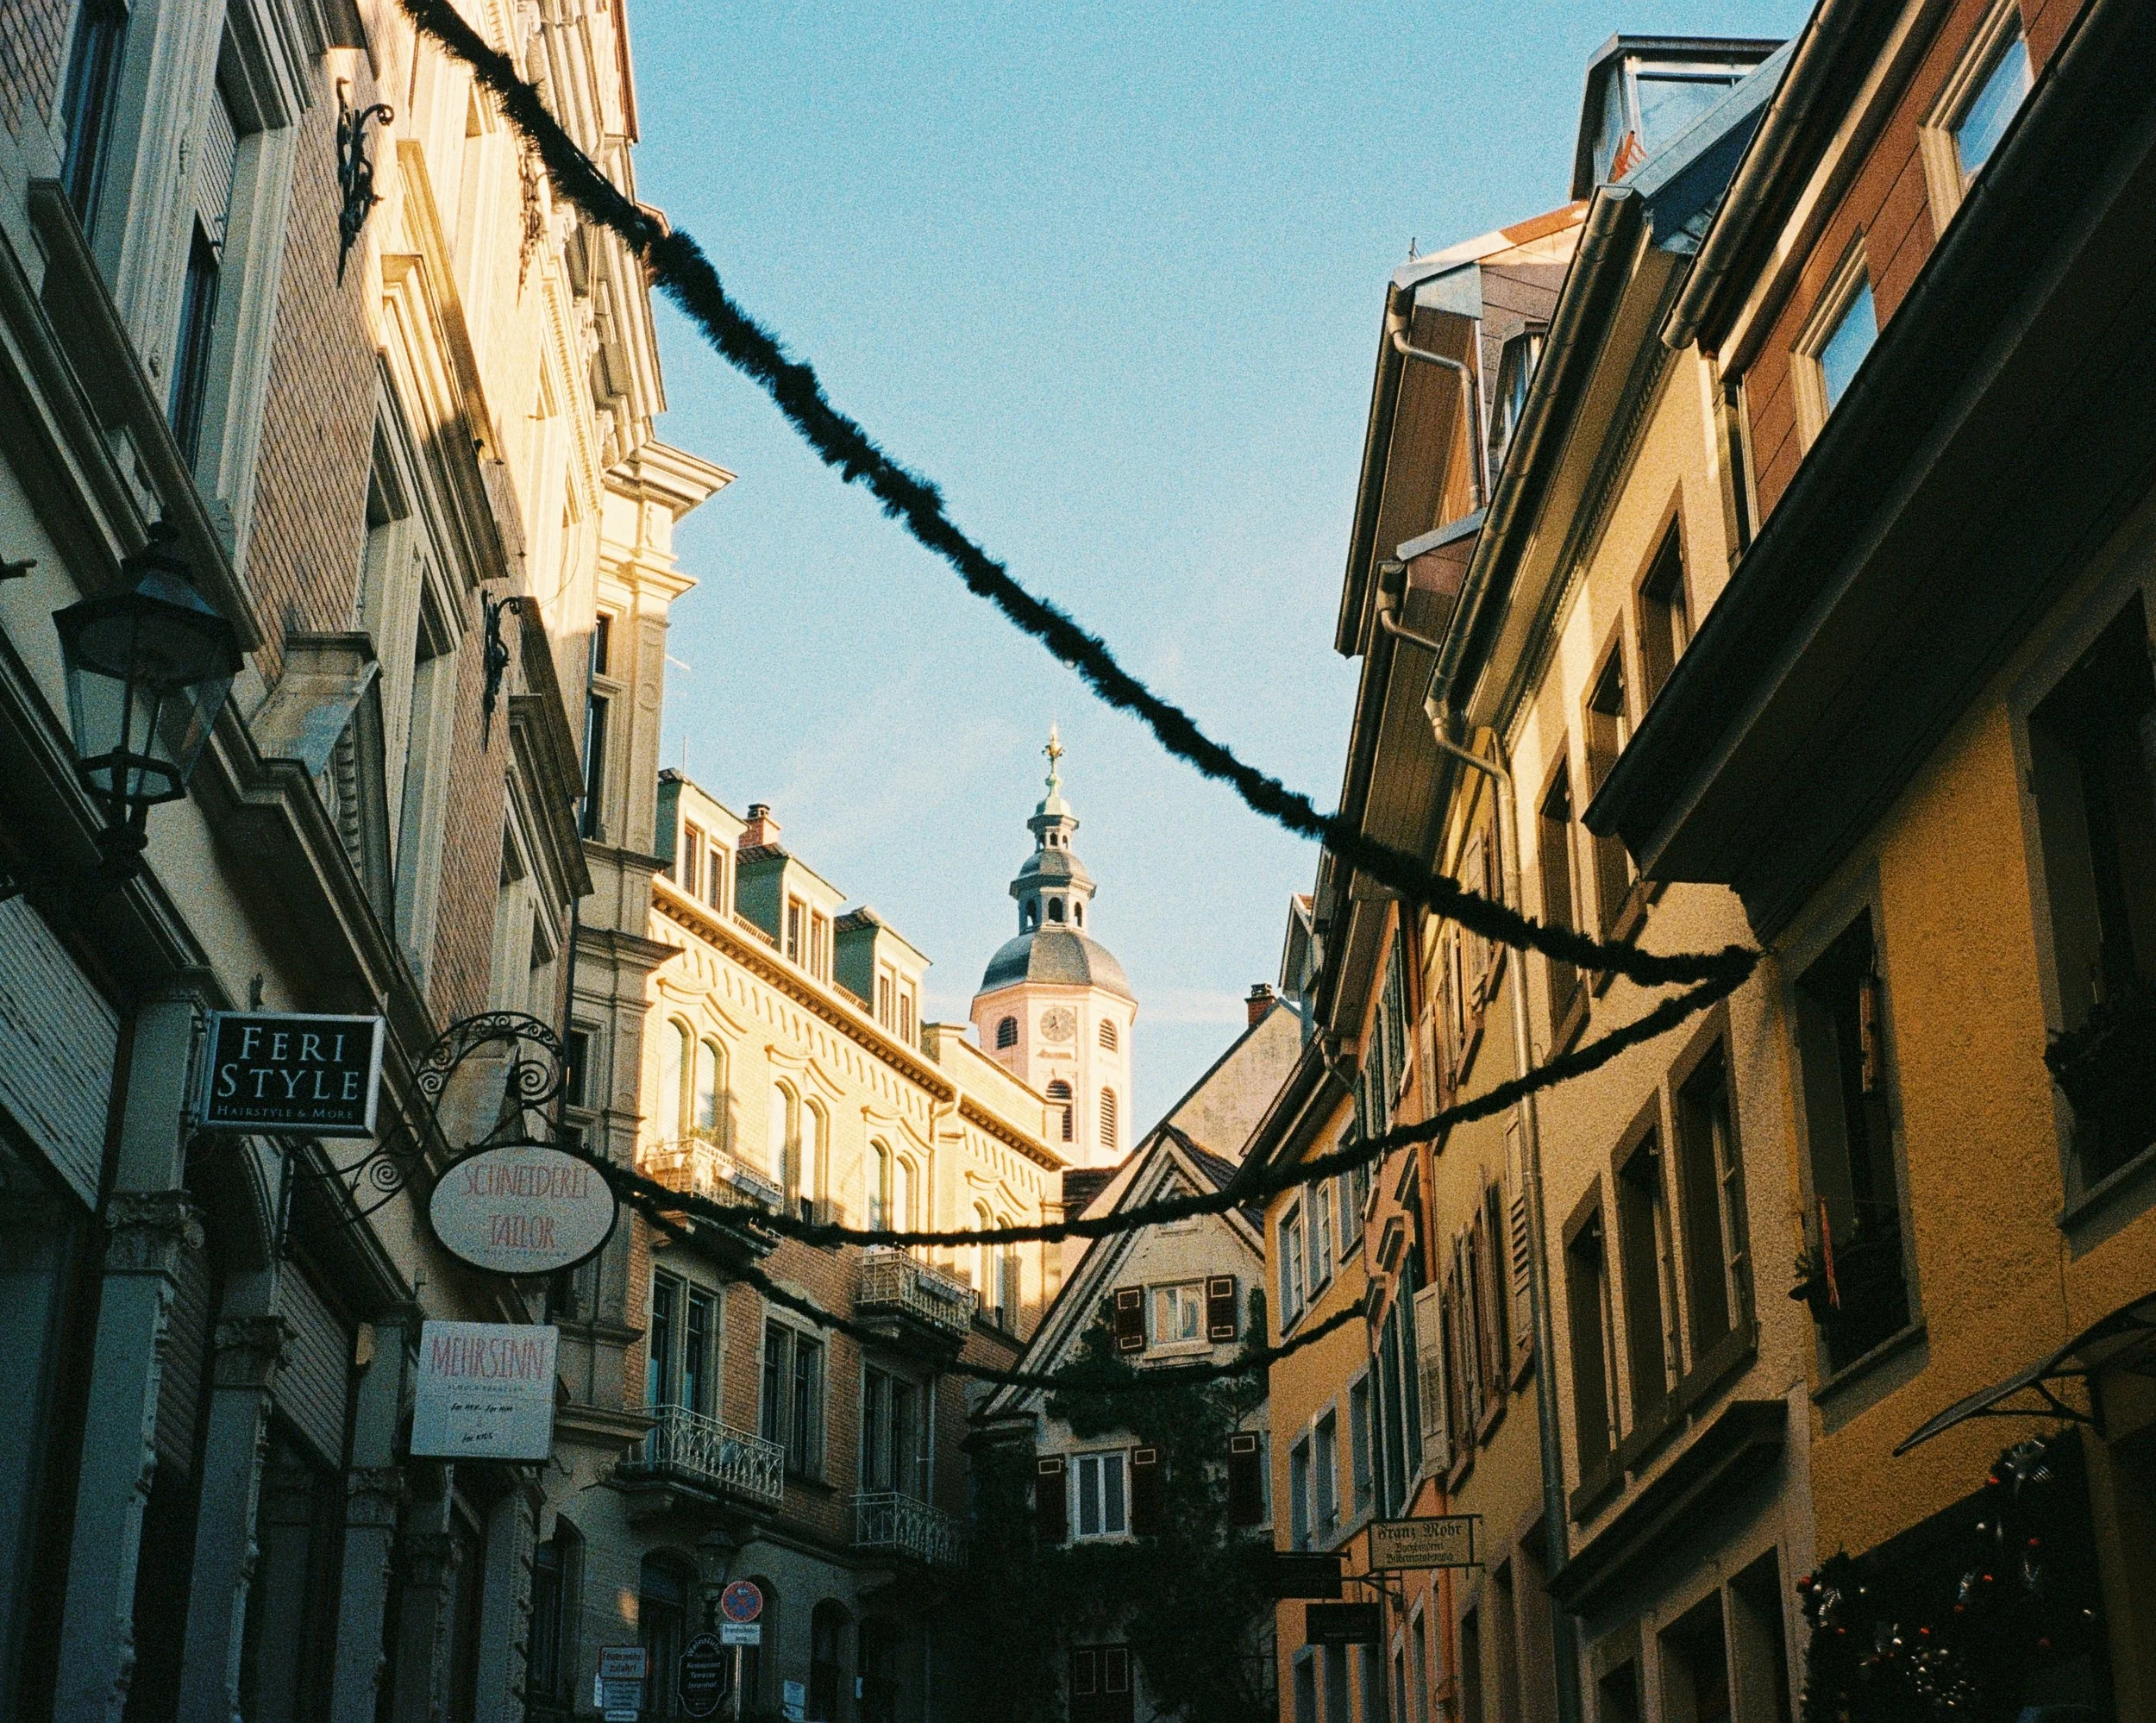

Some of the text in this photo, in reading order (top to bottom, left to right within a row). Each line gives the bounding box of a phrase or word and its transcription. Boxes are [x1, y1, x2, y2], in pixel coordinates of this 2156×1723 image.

[240, 1027, 345, 1062] FERI
[217, 1064, 359, 1100] STYLE
[217, 1105, 291, 1118] HAIRSTYLE
[313, 1109, 354, 1119] MORE
[462, 1163, 588, 1199] SCHNEIDEREI
[489, 1214, 555, 1250] TAILOR
[431, 1336, 545, 1380] MEHRSINN
[1378, 1522, 1462, 1540] Franz Mohr
